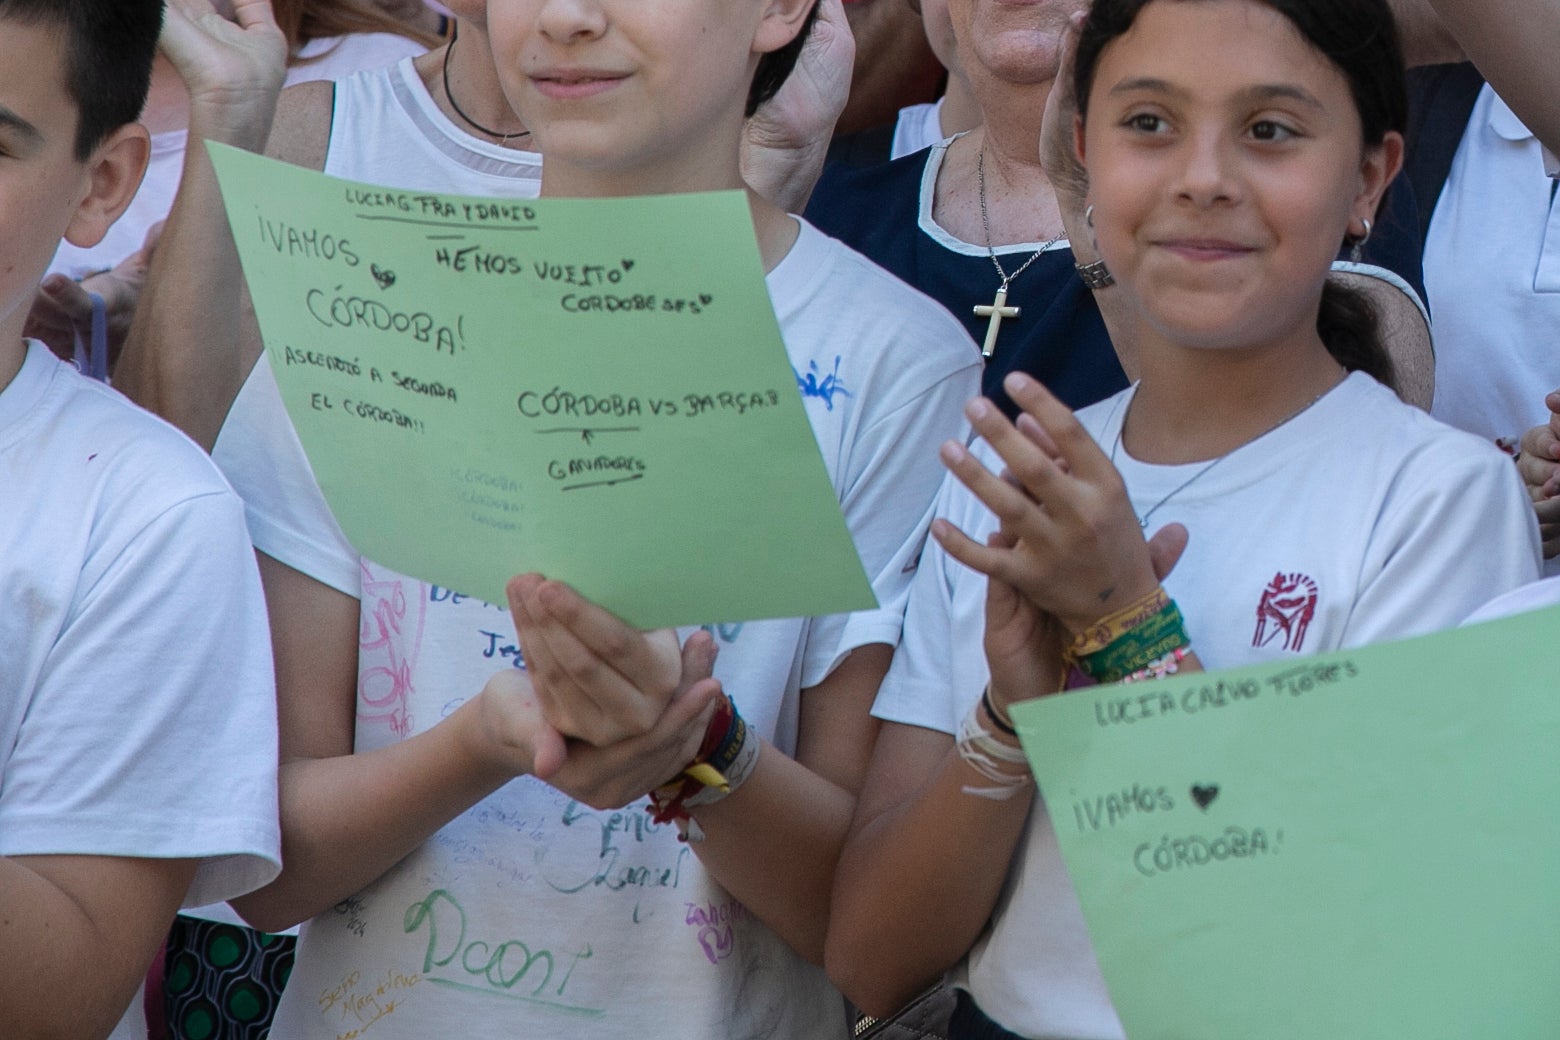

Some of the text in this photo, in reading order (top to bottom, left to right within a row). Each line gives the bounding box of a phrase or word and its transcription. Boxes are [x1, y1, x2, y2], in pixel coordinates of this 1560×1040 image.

[436, 245, 522, 275] HEMOS
[370, 366, 384, 384] A
[311, 393, 334, 412] EL
[517, 385, 642, 418] CÓRDOBA
